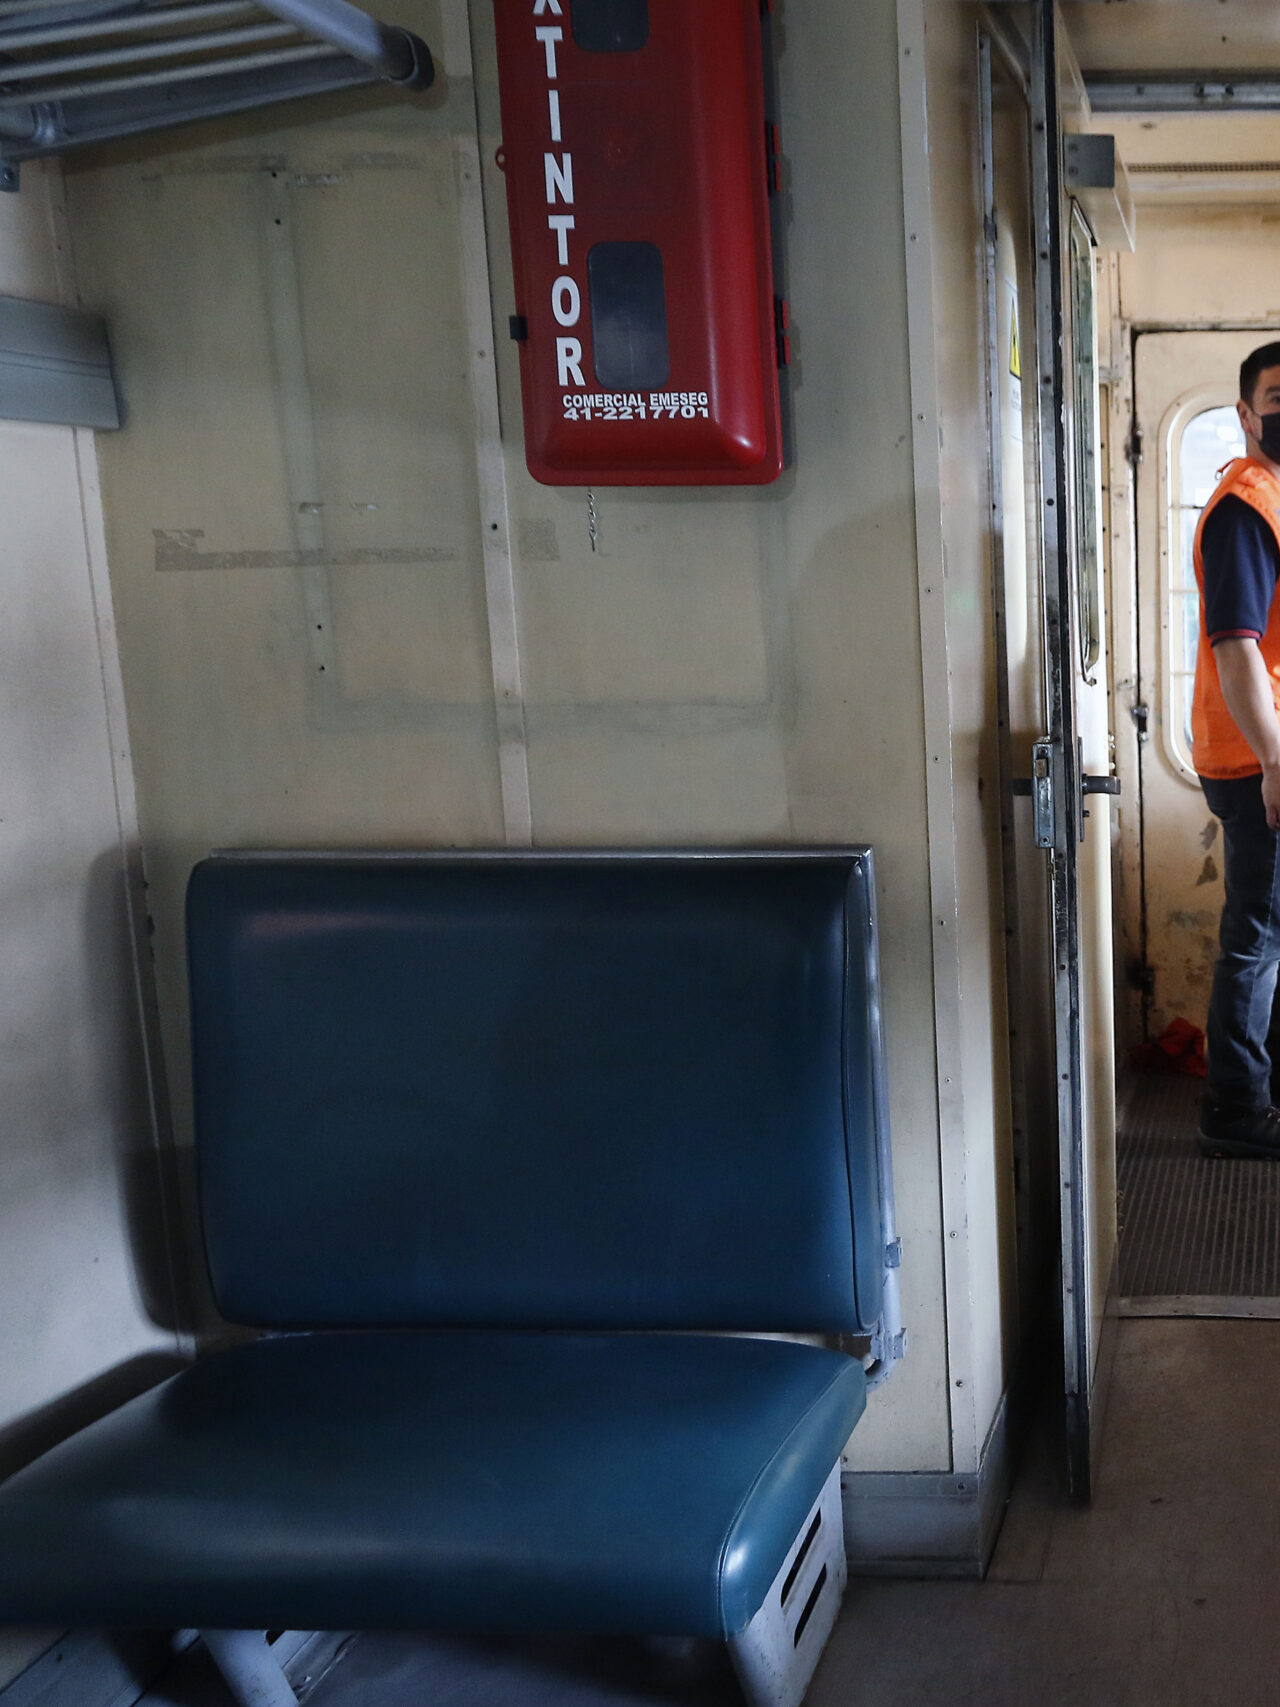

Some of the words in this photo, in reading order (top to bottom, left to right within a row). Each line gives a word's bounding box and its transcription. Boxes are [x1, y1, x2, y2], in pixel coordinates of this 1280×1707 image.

[532, 0, 586, 387] TINTOR
[562, 393, 647, 408] COMERCIAL
[649, 392, 708, 405] EMESEG
[563, 405, 709, 420] 41-2217701
